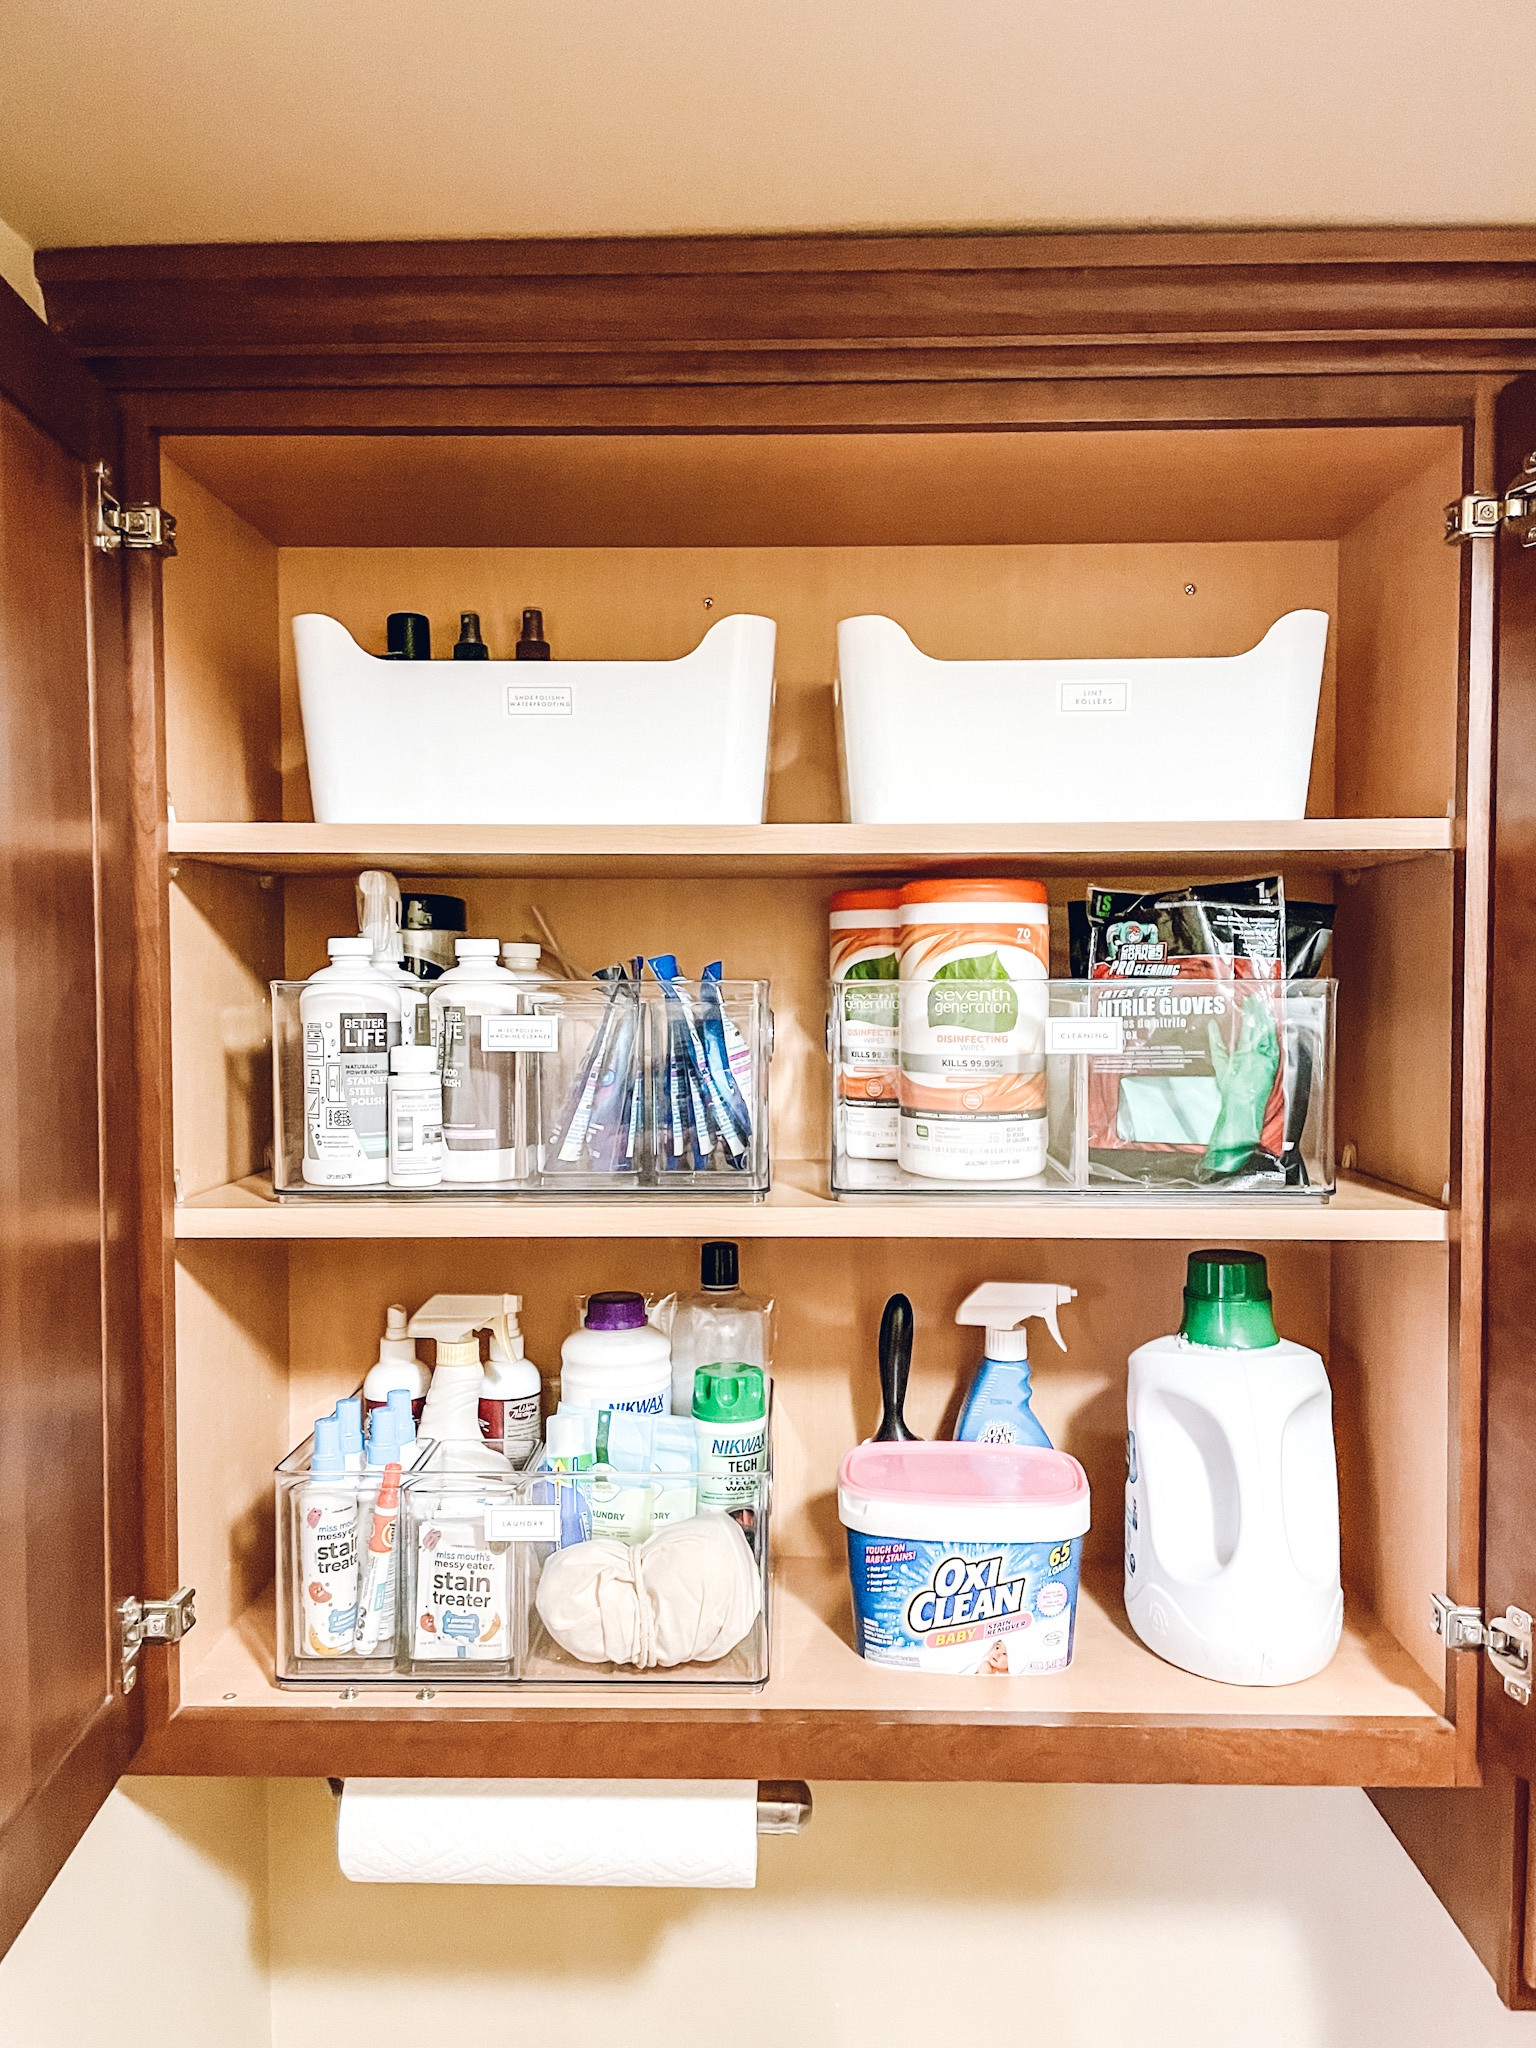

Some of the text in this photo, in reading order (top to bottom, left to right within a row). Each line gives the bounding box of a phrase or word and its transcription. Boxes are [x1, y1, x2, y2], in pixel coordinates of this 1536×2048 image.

[1016, 927, 1031, 939] 70
[935, 988, 1011, 1001] seventh
[1098, 986, 1173, 999] LATEX FREE
[1097, 995, 1226, 1017] NITRILE GLOVES
[343, 1018, 385, 1029] BETTER
[344, 1029, 387, 1047] LIFE
[936, 1034, 1009, 1043] DISINFECTING
[941, 1059, 1003, 1068] KILLS 99.99%
[346, 1076, 387, 1086] STAINLE
[349, 1087, 375, 1096] STEEL
[350, 1096, 386, 1106] POLISH
[728, 1457, 758, 1473] TECH
[318, 1524, 338, 1533] miss
[316, 1529, 348, 1541] messy
[865, 1543, 906, 1555] TOUGH ON
[1048, 1539, 1072, 1568] 65
[436, 1552, 491, 1562] miss mouth's
[434, 1560, 465, 1571] messy
[433, 1570, 491, 1593] stain
[933, 1556, 1003, 1598] OXI
[432, 1591, 491, 1608] treater
[907, 1577, 1026, 1633] CLEAN
[987, 1620, 1026, 1635] REMOVER
[988, 1619, 1012, 1629] STAIN
[935, 1628, 977, 1646] BABY
